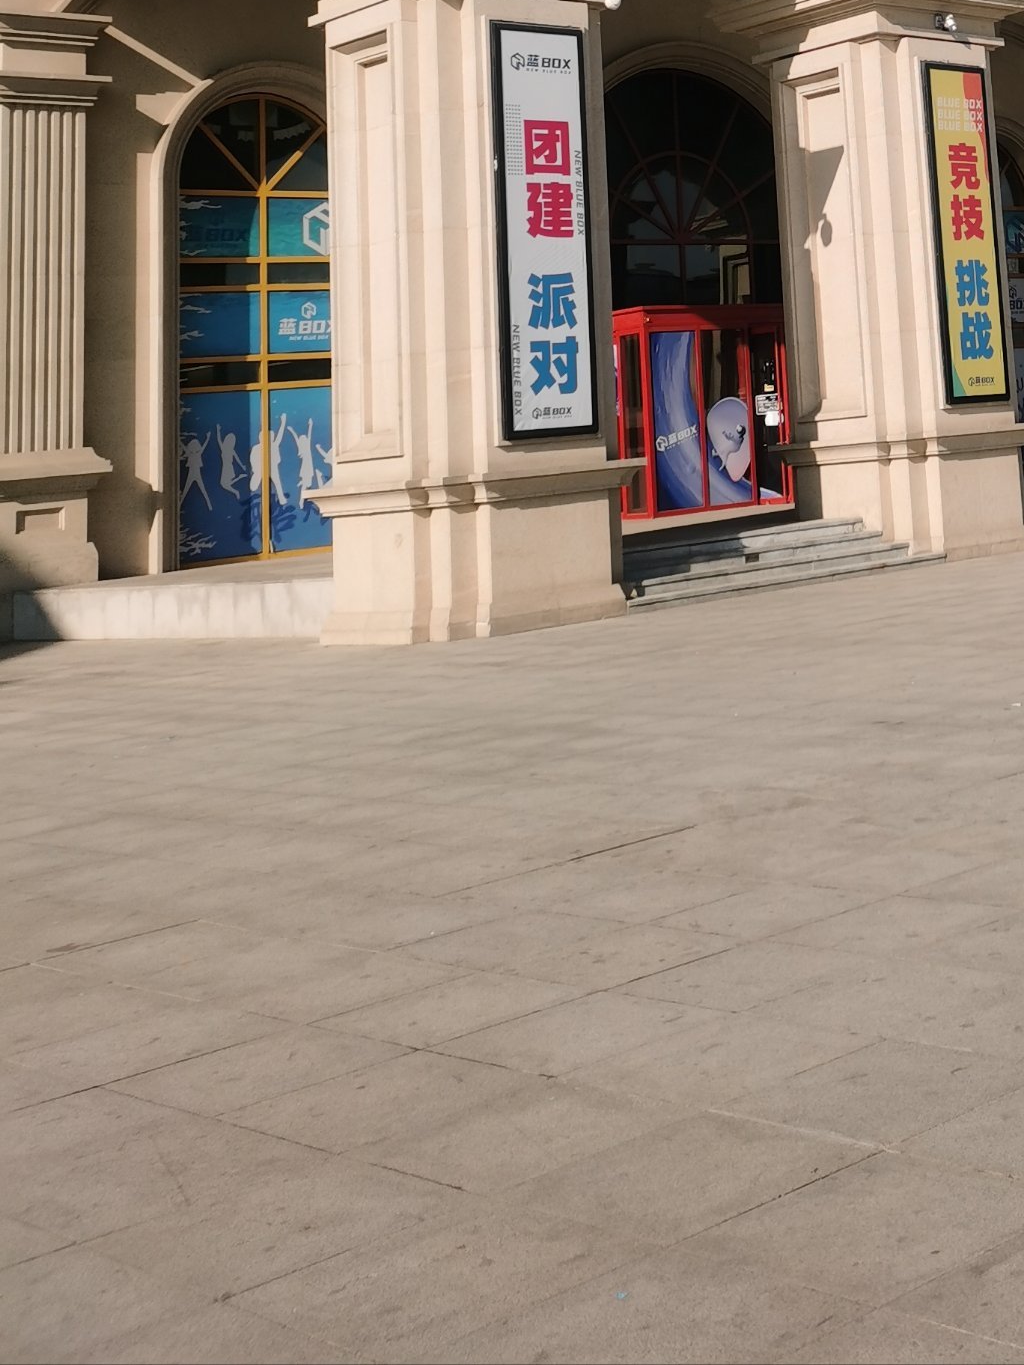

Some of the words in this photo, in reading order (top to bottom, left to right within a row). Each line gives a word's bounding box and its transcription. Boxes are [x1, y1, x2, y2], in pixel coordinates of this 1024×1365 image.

[526, 54, 572, 70] 蓝BOX
[937, 97, 961, 108] BLUE
[964, 98, 983, 109] BOX
[938, 109, 961, 120] BLUE
[964, 110, 984, 121] BOX
[938, 120, 961, 131] BLUE
[964, 122, 984, 133] BOX
[574, 150, 583, 176] NEW
[523, 119, 575, 238] 团建
[948, 143, 985, 241] 竞技
[576, 181, 584, 209] BLUE
[577, 212, 586, 236] BOX
[955, 259, 994, 361] 挑战
[512, 324, 521, 353] NEW
[527, 272, 579, 396] 派对
[513, 358, 522, 387] BLUE
[514, 391, 523, 416] BOX
